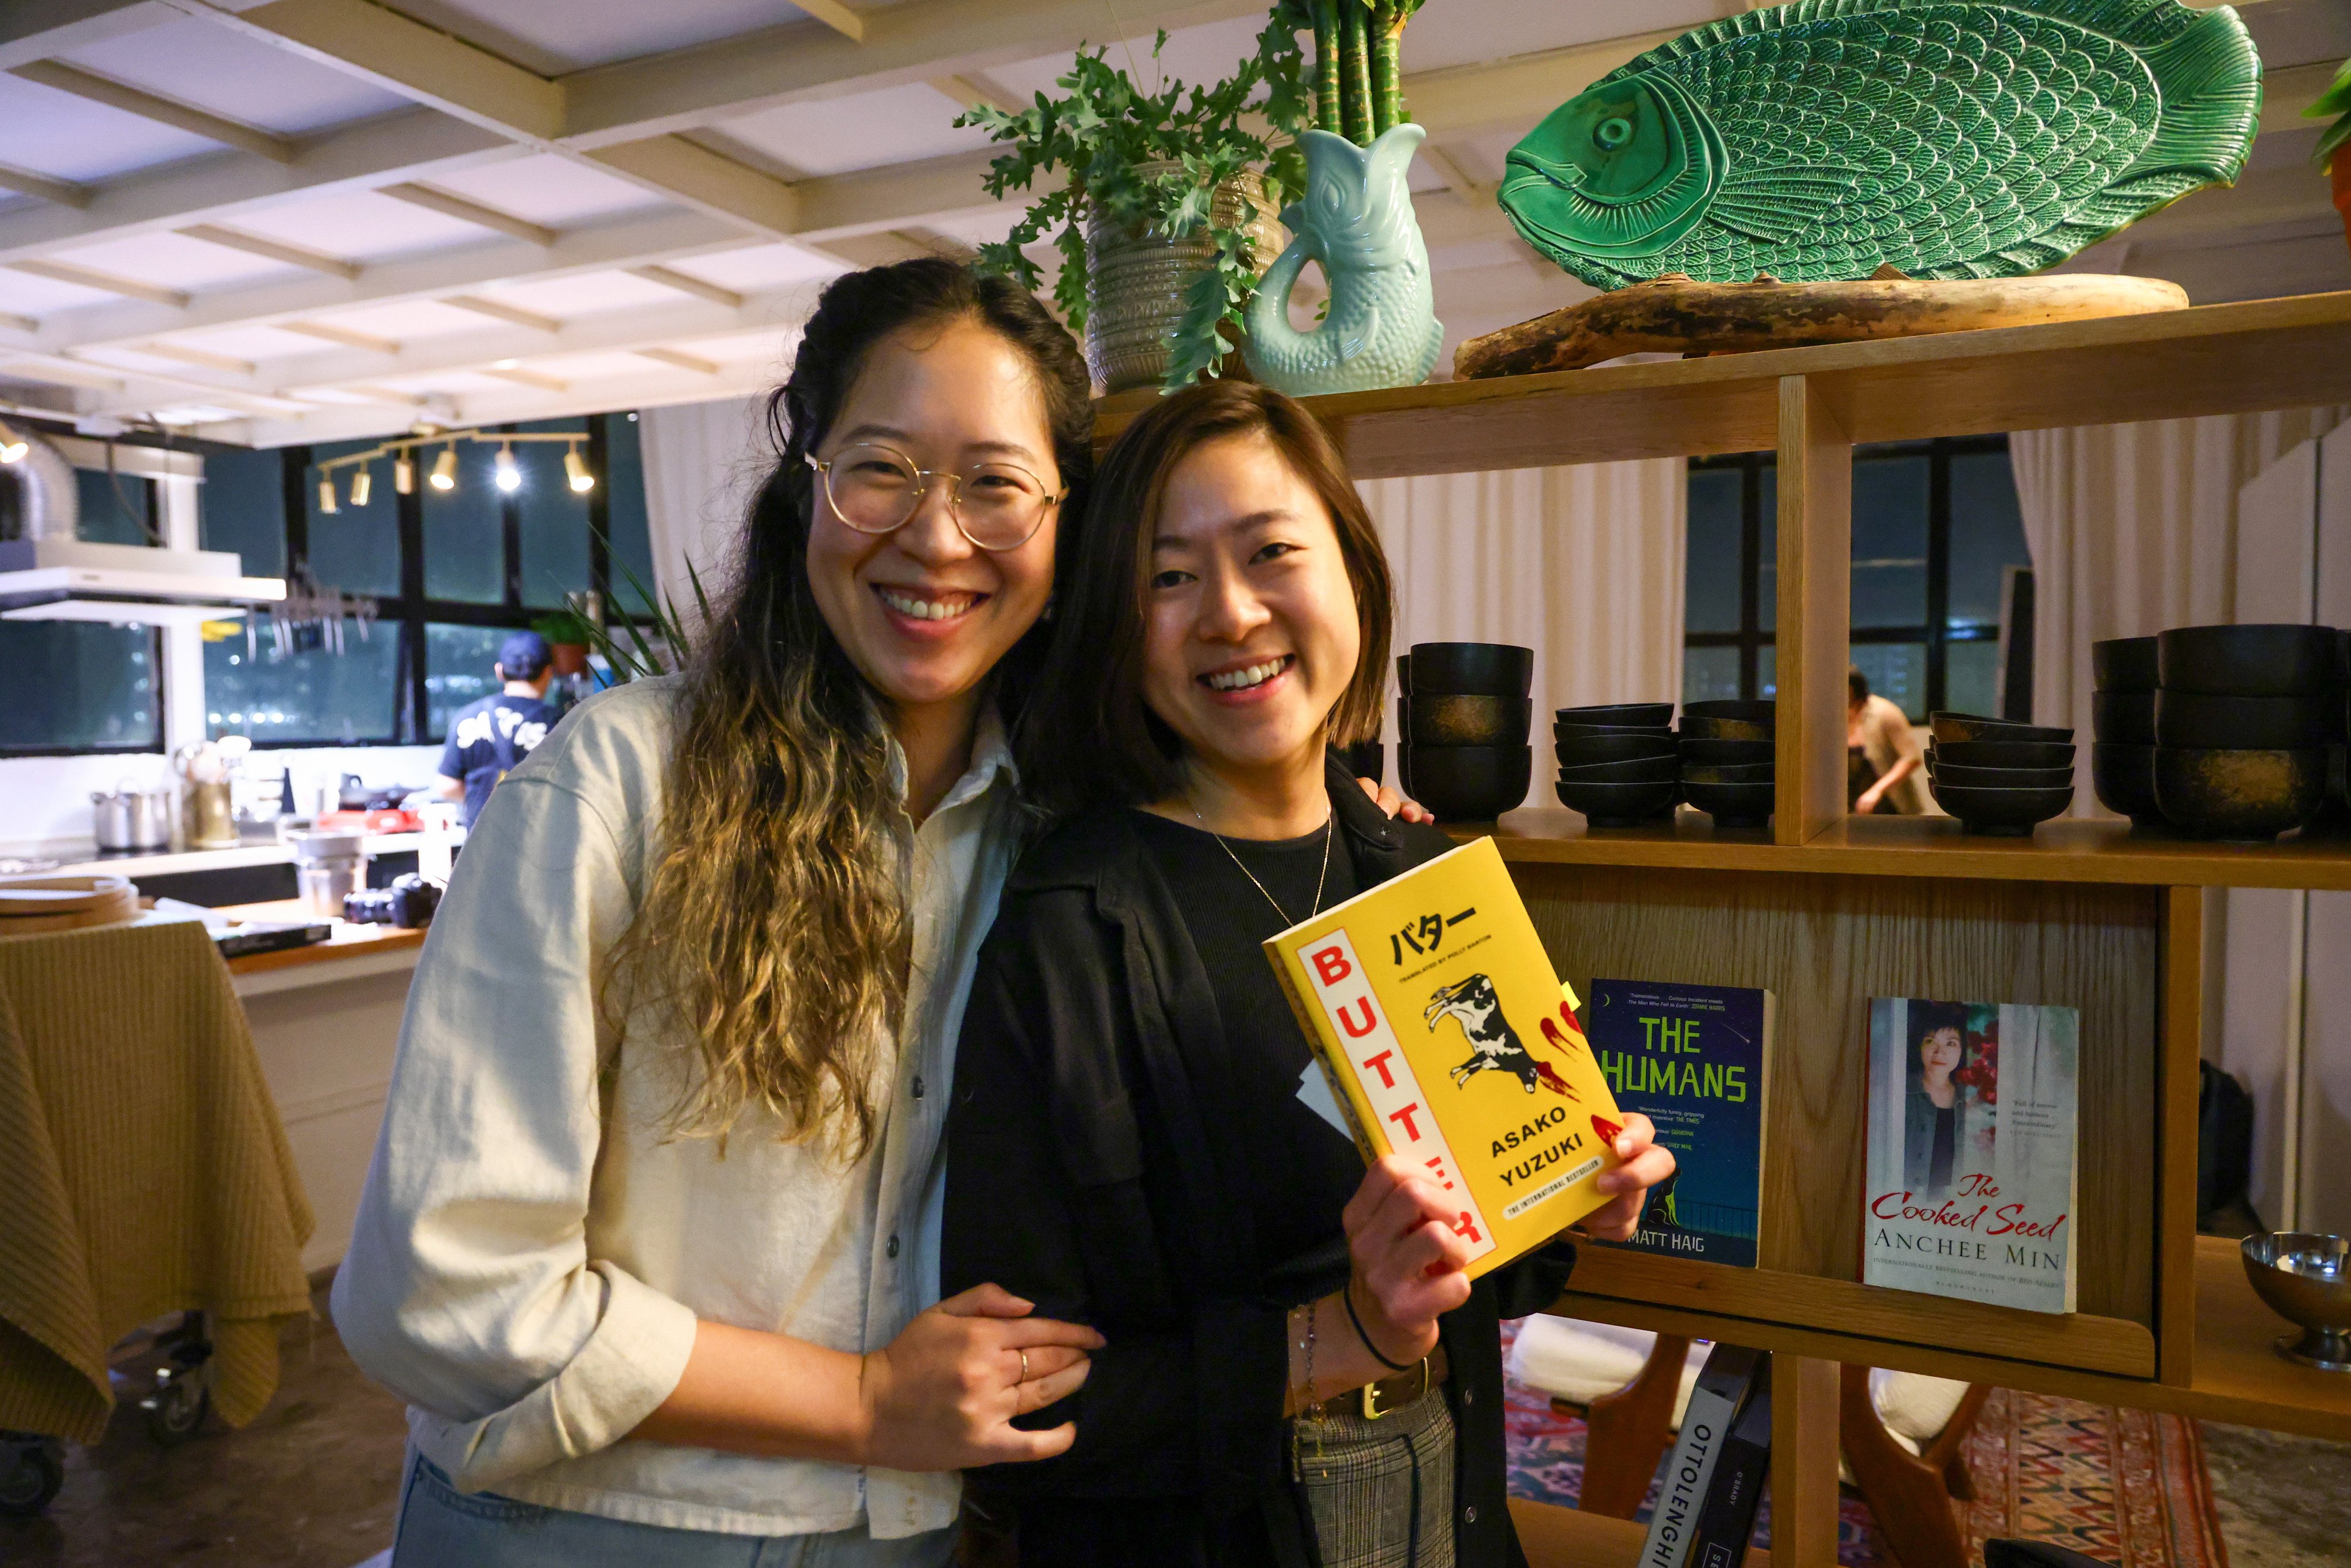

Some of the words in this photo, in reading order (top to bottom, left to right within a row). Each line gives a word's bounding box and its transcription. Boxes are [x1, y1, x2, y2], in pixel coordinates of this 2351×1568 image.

[1391, 907, 1476, 966] バター
[1639, 1016, 1701, 1054] THE
[1311, 946, 1482, 1244] BUTTR
[1601, 1050, 1746, 1102] HUMANS
[1492, 1106, 1566, 1158] ASAKO
[1500, 1133, 1583, 1187] YUZUKI
[1958, 1174, 2000, 1197] The
[1628, 1229, 1668, 1246] MATT
[1672, 1233, 1705, 1252] HAIG
[1872, 1191, 1988, 1232] Cooked
[1986, 1204, 2066, 1241] Seed
[1873, 1257, 1933, 1270] INTERNATIONALLY
[1874, 1228, 1988, 1260] ANCHEE
[2005, 1244, 2060, 1271] MIN
[1652, 1424, 1711, 1568] OTTOLENGHI
